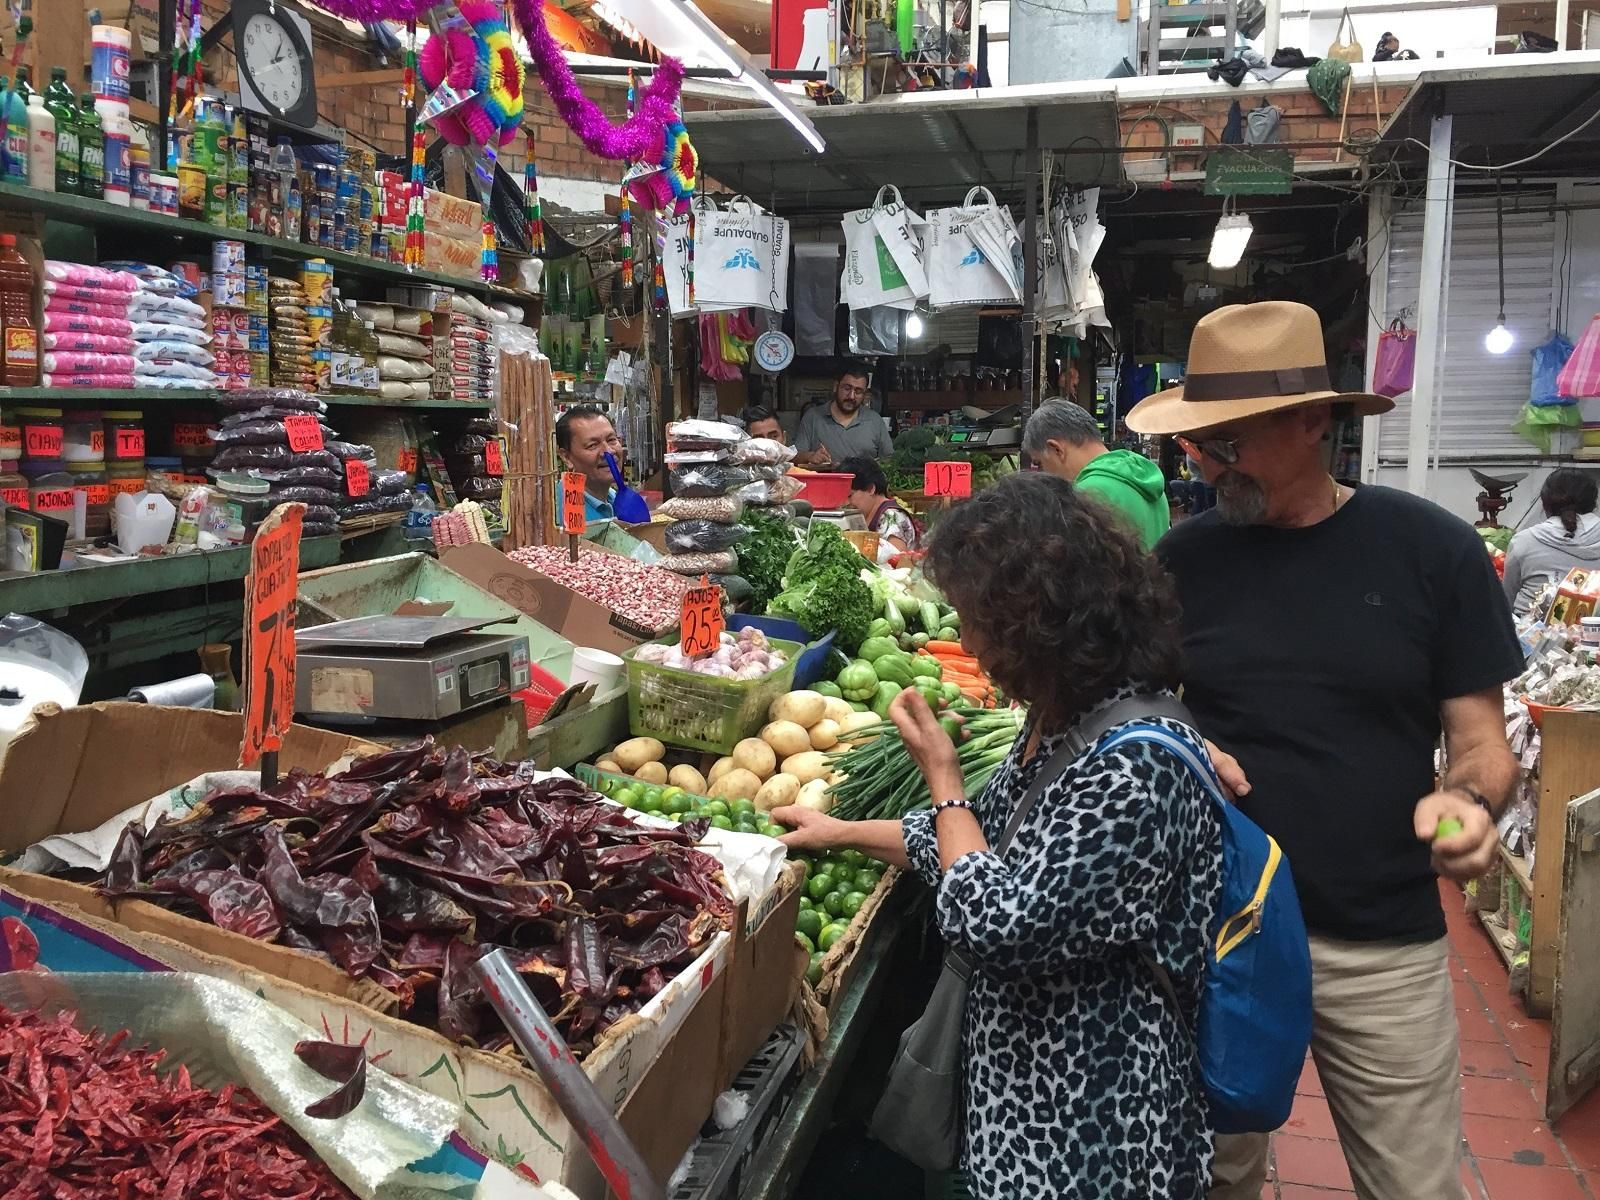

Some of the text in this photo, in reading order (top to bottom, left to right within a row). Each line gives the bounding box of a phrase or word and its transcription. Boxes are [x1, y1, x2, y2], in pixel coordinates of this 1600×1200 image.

[714, 227, 769, 243] GUADALUPE
[294, 434, 319, 448] COLIMA
[933, 464, 952, 496] 12
